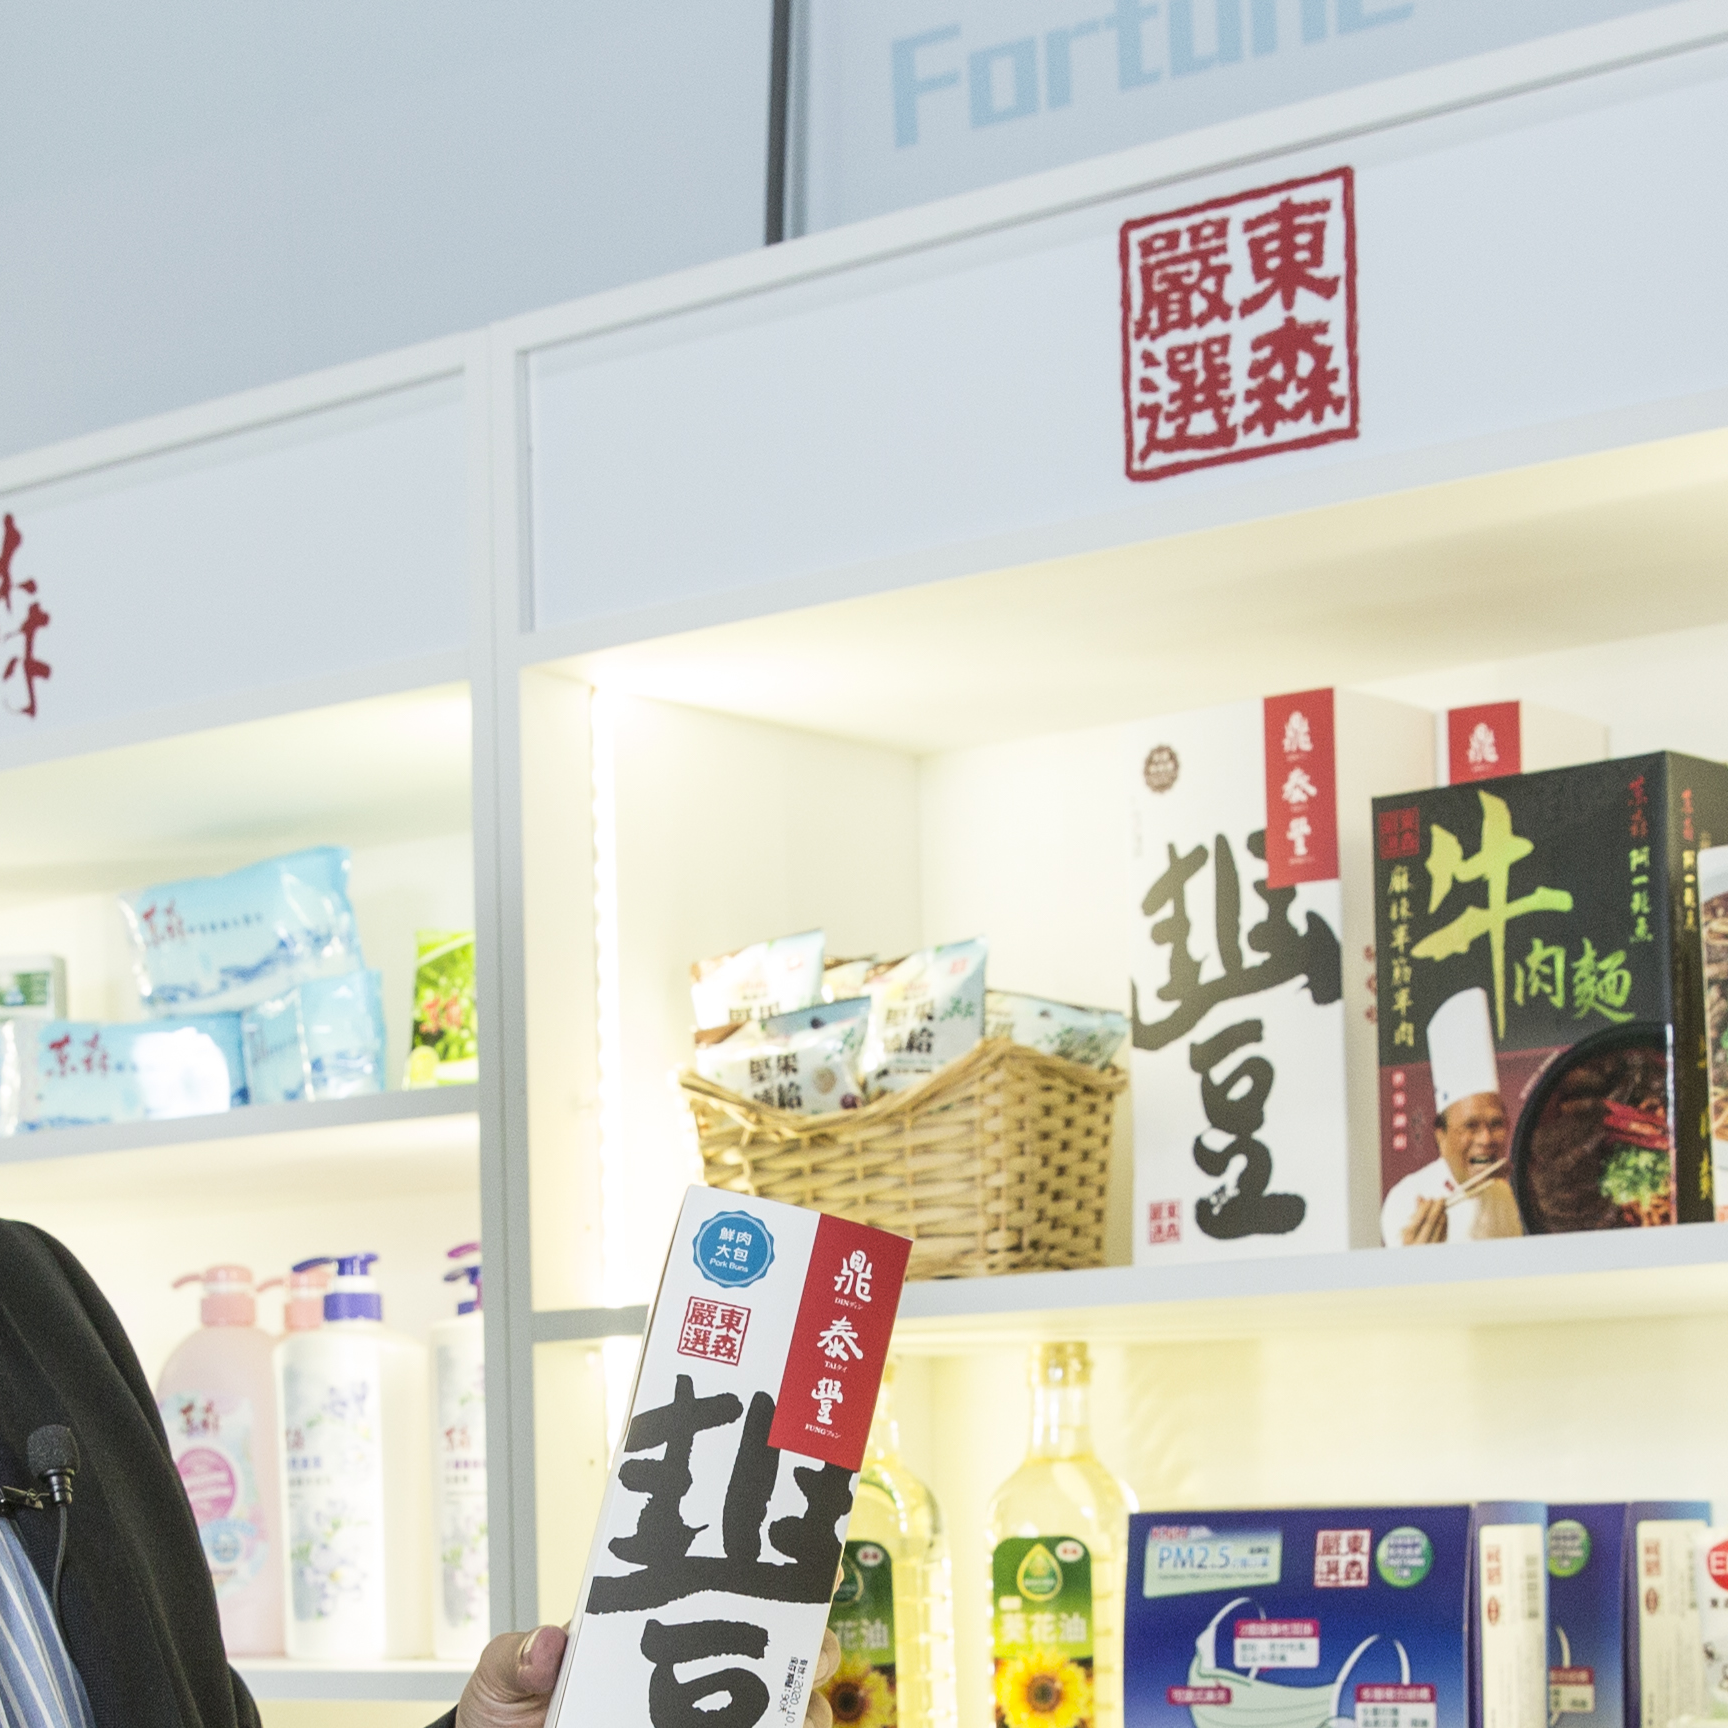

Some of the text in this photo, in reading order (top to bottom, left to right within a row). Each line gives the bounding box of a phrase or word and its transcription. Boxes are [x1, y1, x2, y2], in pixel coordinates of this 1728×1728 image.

[1239, 197, 1347, 438] 東森
[1135, 215, 1240, 464] 嚴選
[714, 1244, 749, 1263] 大包
[718, 1226, 753, 1247] 鮮肉
[710, 1258, 749, 1273] Pork Buns
[683, 1301, 717, 1356] 嚴選
[713, 1308, 745, 1361] 東森
[811, 1249, 873, 1426] 鼎泰豐
[1157, 1543, 1232, 1570] PM2.5
[835, 1618, 889, 1650] 花油
